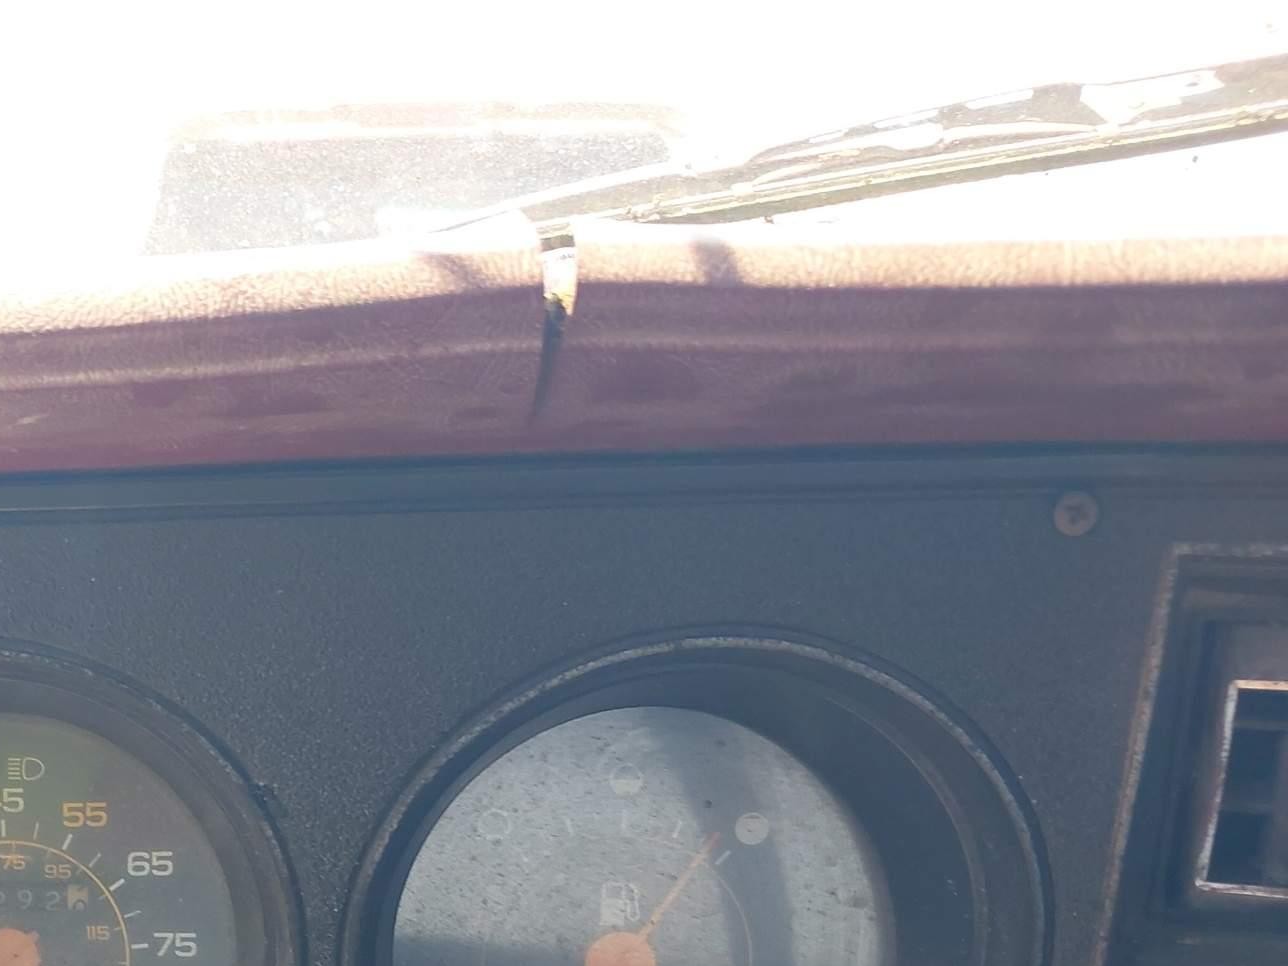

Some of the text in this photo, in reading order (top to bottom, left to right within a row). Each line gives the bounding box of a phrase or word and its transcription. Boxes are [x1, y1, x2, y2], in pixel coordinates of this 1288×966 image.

[62, 802, 107, 827] 55
[0, 855, 25, 870] 75
[44, 864, 71, 879] 95
[127, 851, 173, 876] 65
[87, 925, 110, 940] 115
[153, 933, 197, 957] 75
